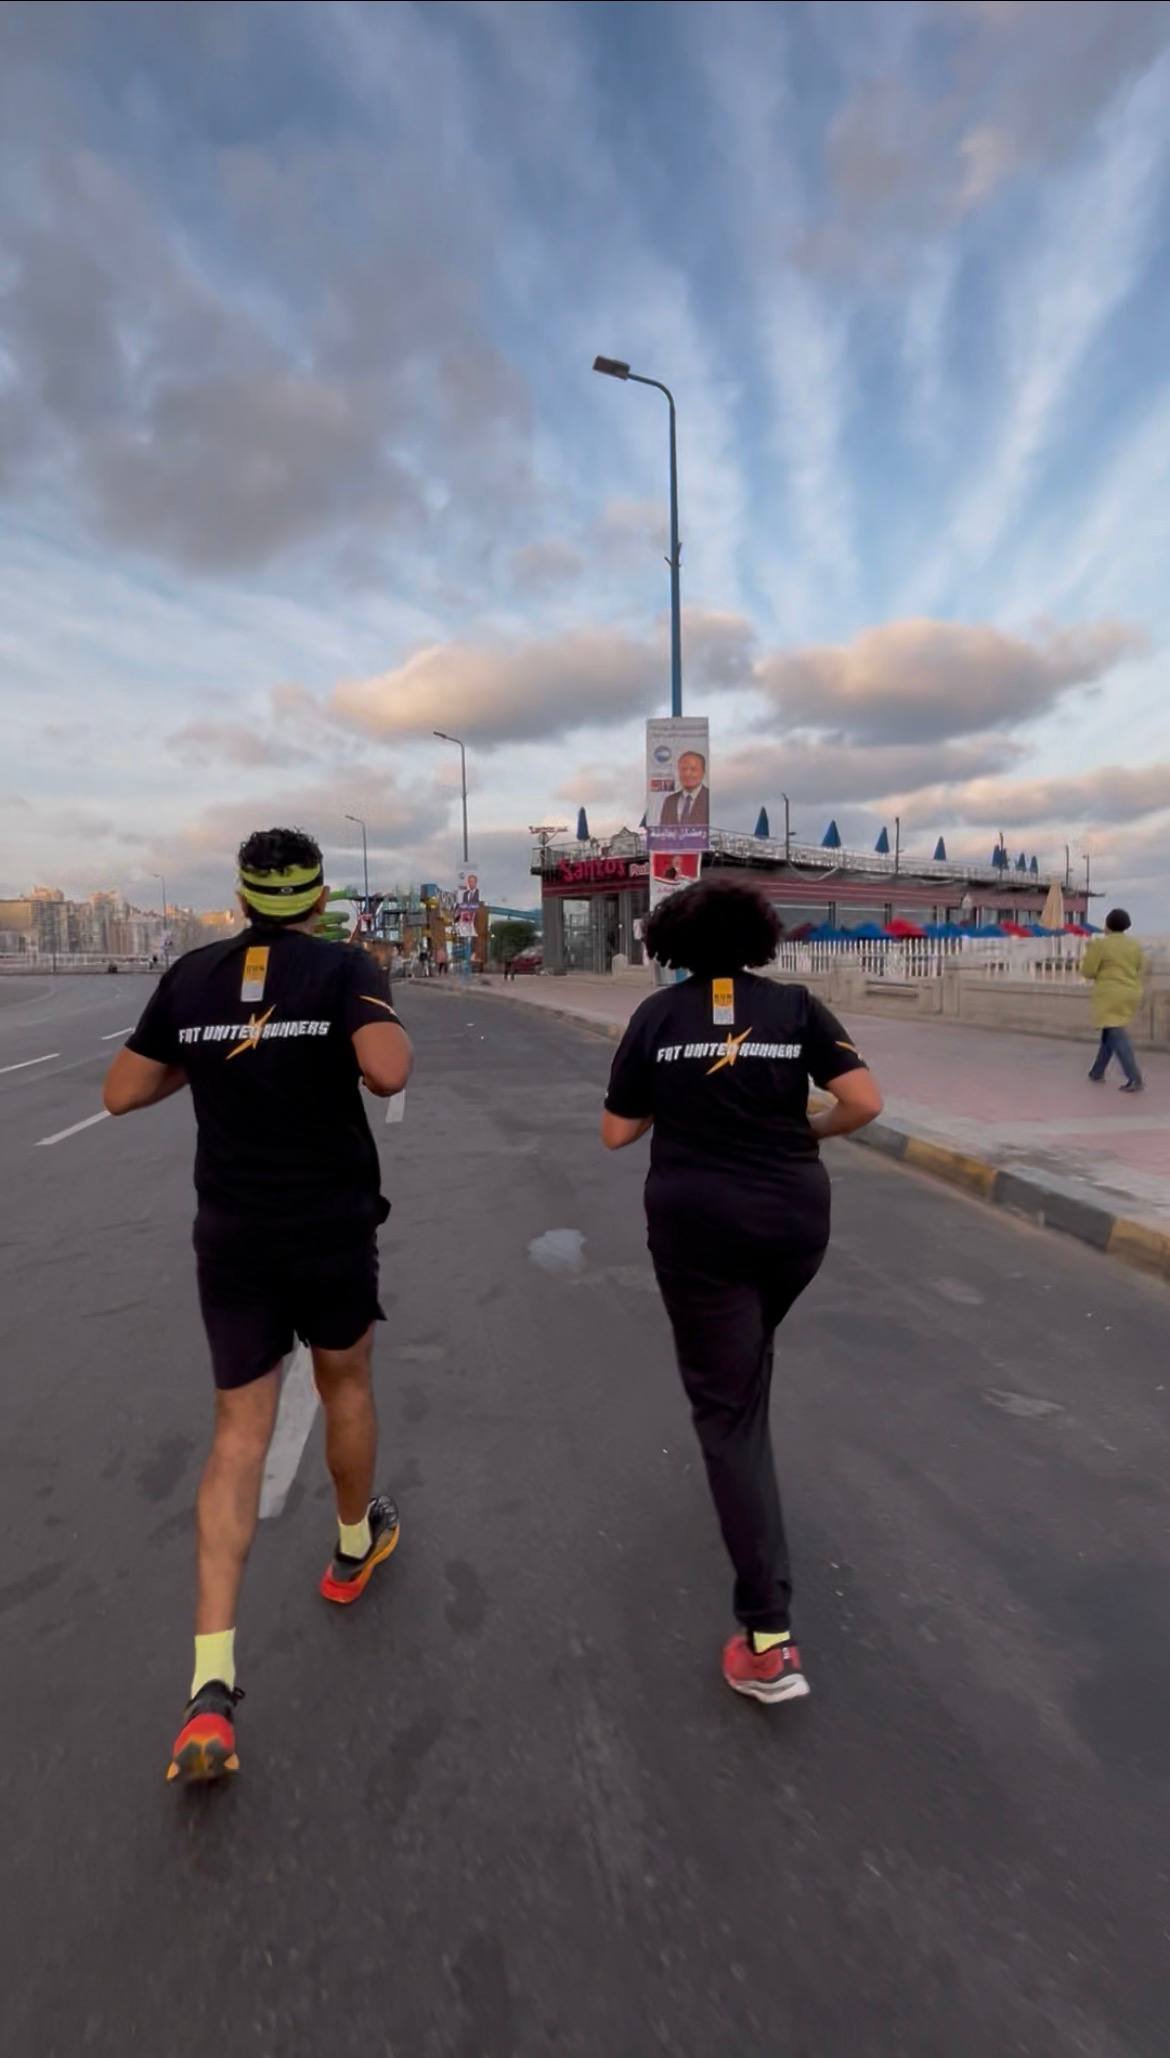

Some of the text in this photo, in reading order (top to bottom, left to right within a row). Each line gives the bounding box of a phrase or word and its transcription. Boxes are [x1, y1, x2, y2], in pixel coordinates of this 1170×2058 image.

[559, 857, 625, 882] Santos
[262, 1020, 331, 1039] RUNNERS
[739, 1042, 802, 1060] RUNNERS
